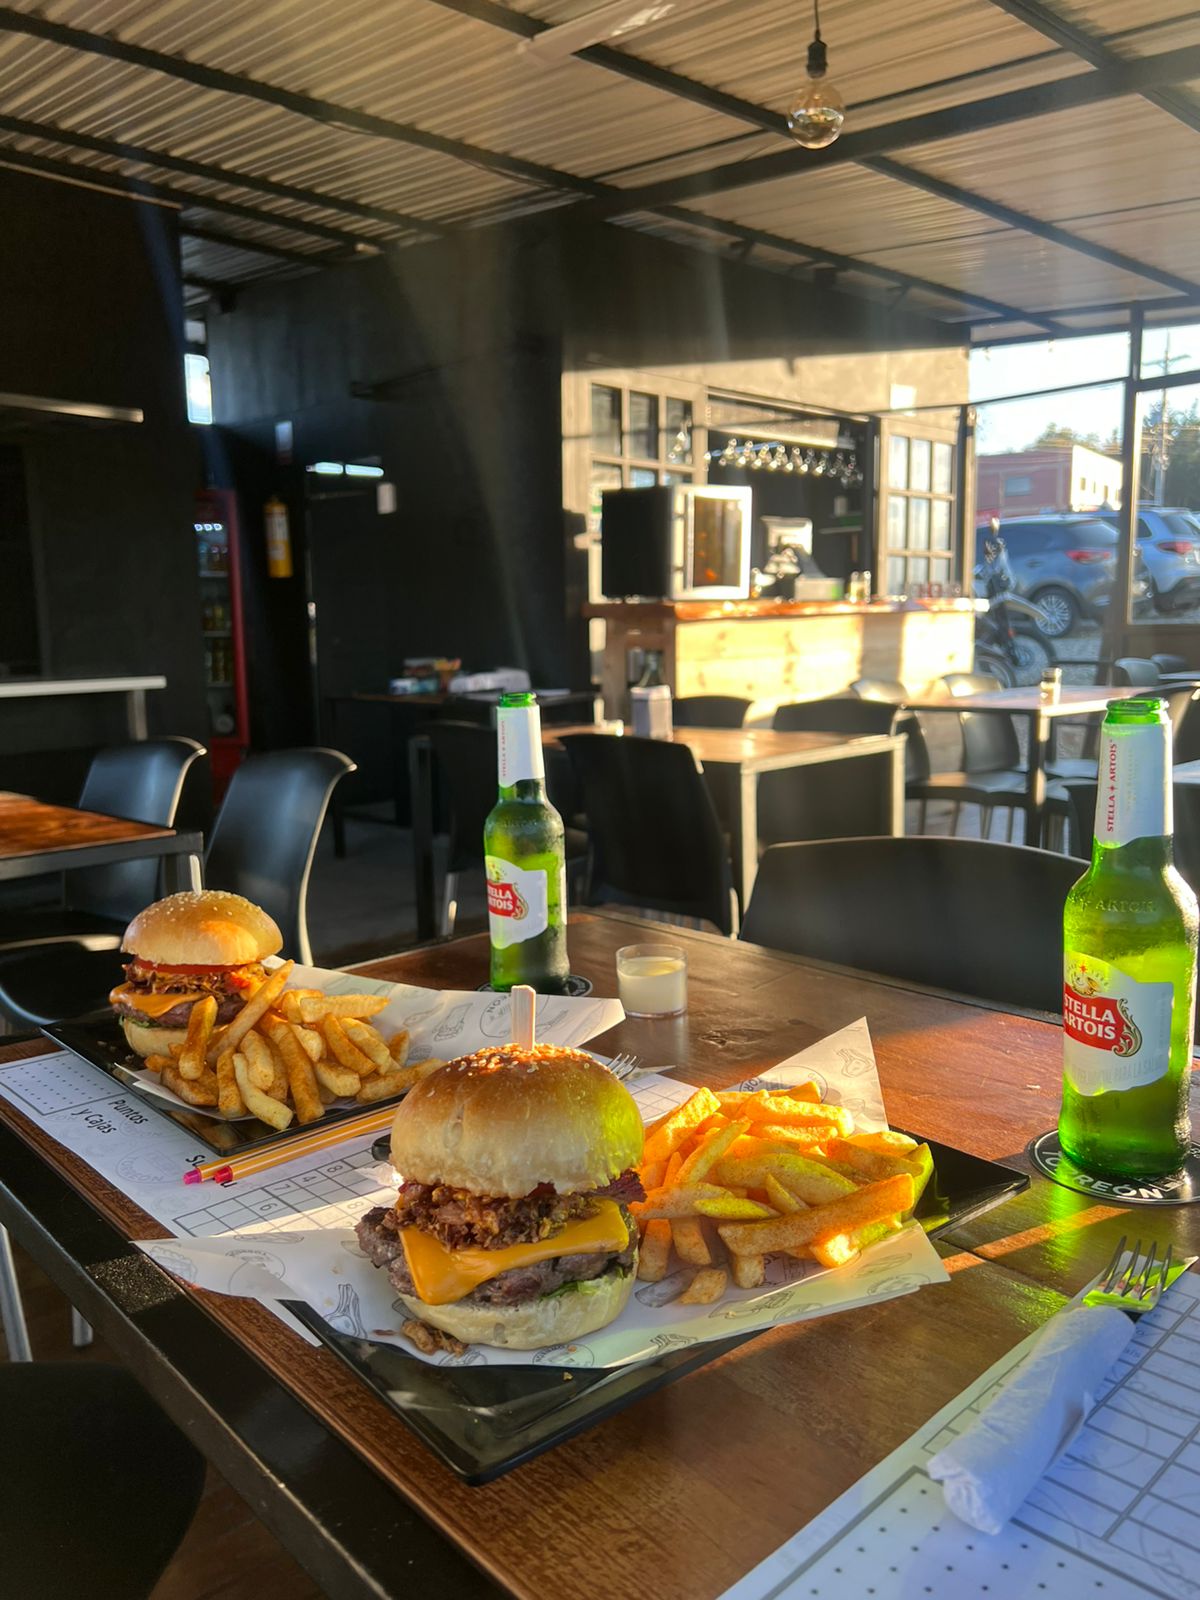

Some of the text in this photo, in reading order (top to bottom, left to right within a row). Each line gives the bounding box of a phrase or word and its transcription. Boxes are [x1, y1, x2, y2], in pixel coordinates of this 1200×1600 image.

[1106, 743, 1117, 832] STELLA ARTOIS
[1063, 993, 1116, 1025] STELLA
[71, 1108, 90, 1116] y
[84, 1113, 117, 1135] Cajas
[108, 1099, 149, 1125] Puntos
[301, 1175, 317, 1183] 4
[326, 1164, 344, 1174] 8
[273, 1183, 290, 1191] 7
